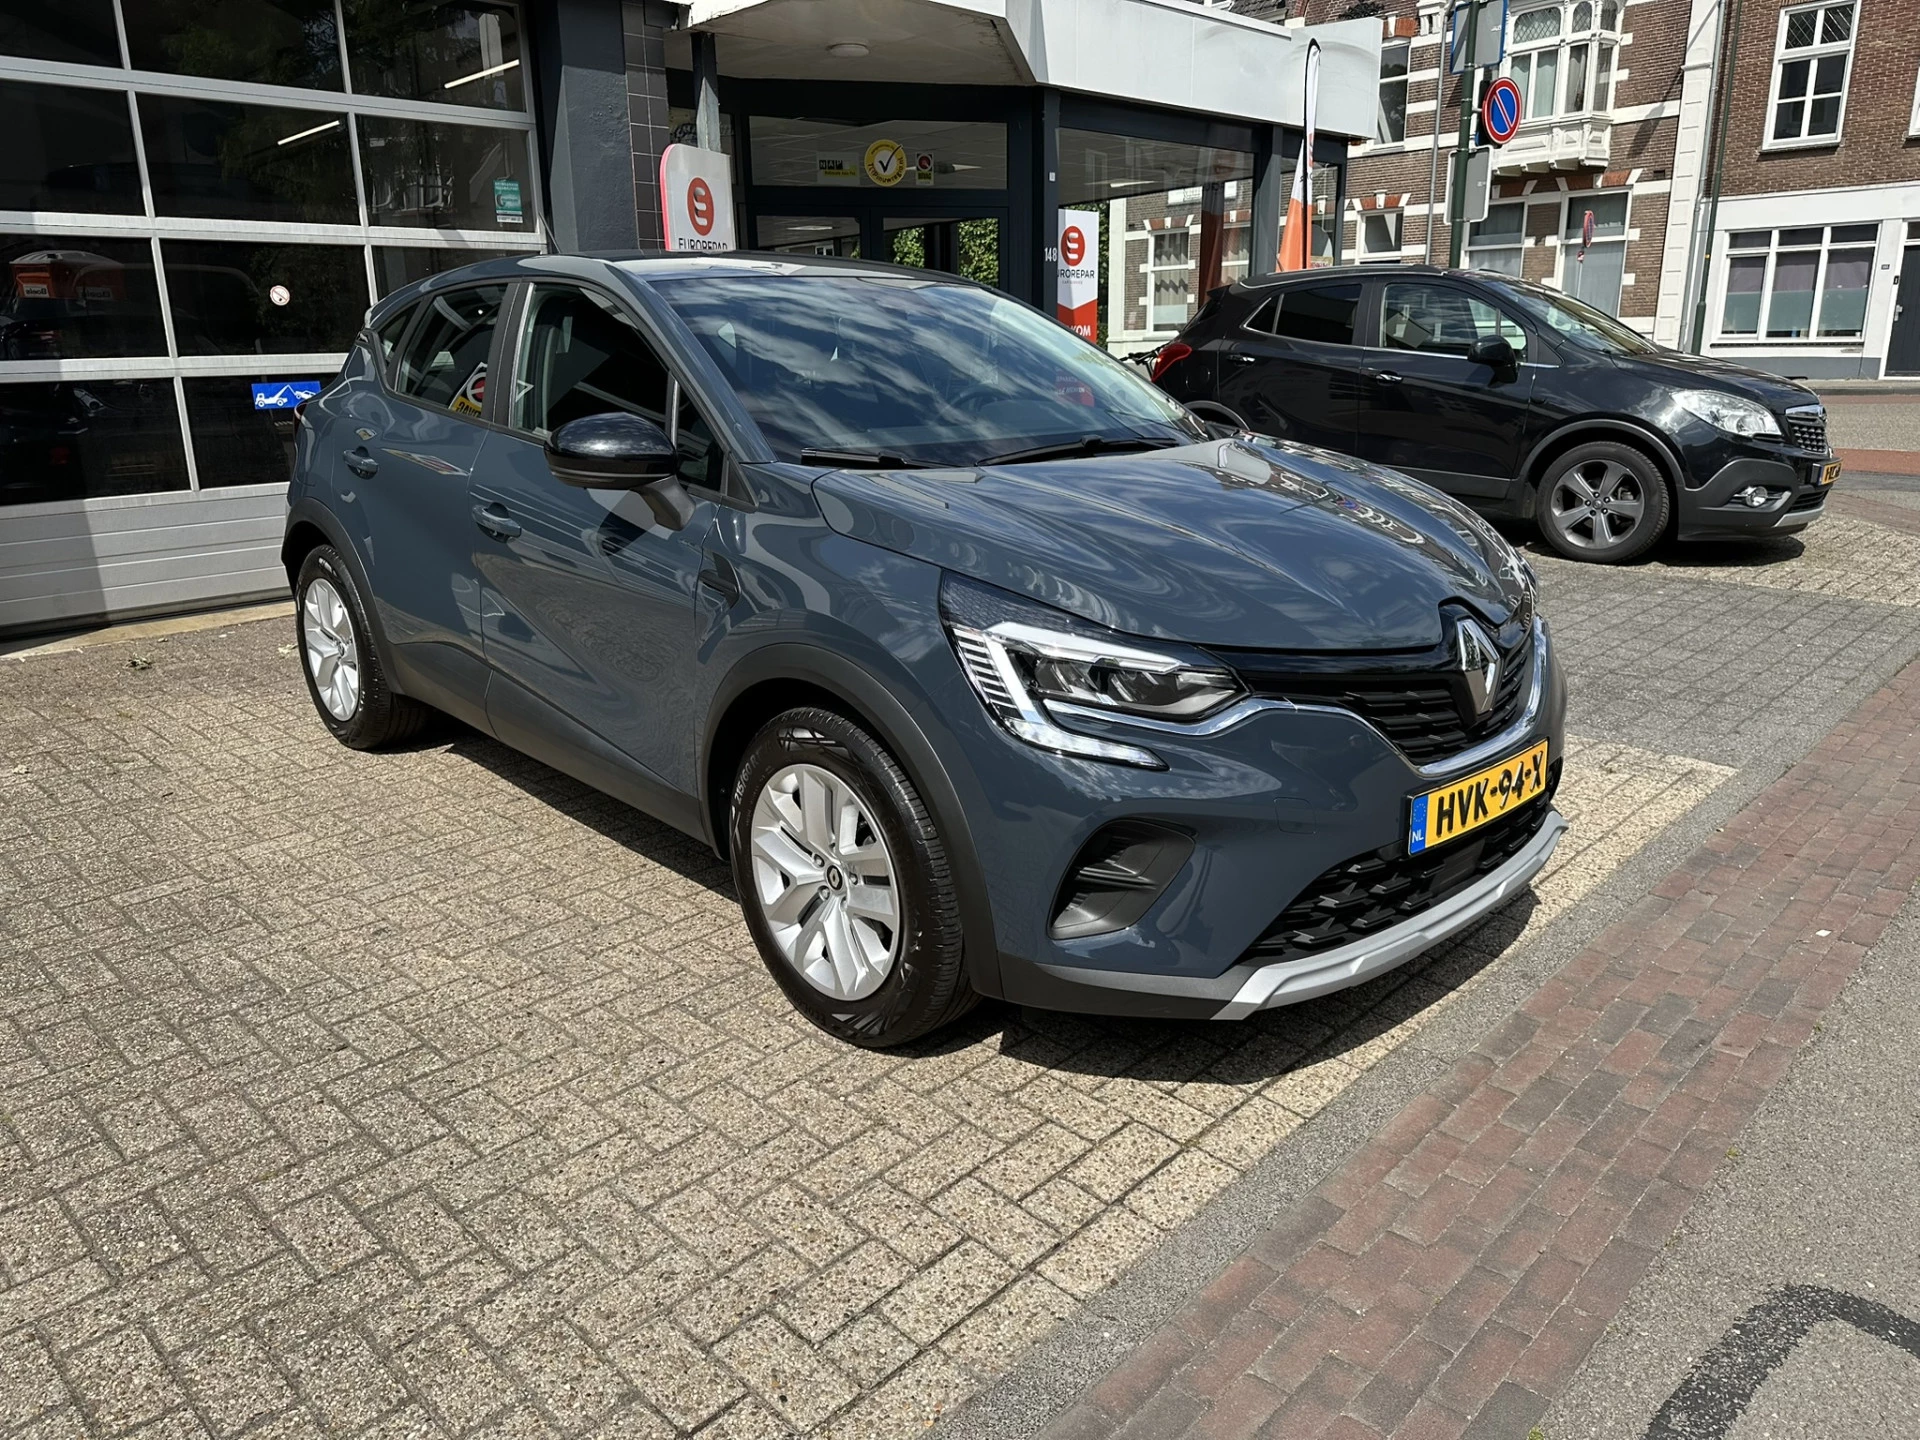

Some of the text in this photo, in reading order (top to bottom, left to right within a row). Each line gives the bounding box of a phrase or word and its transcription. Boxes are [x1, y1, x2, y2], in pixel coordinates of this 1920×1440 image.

[1044, 247, 1058, 262] 148
[734, 762, 753, 805] 215/60
[1436, 750, 1545, 839] HVK-94-X
[1411, 828, 1424, 844] NL
